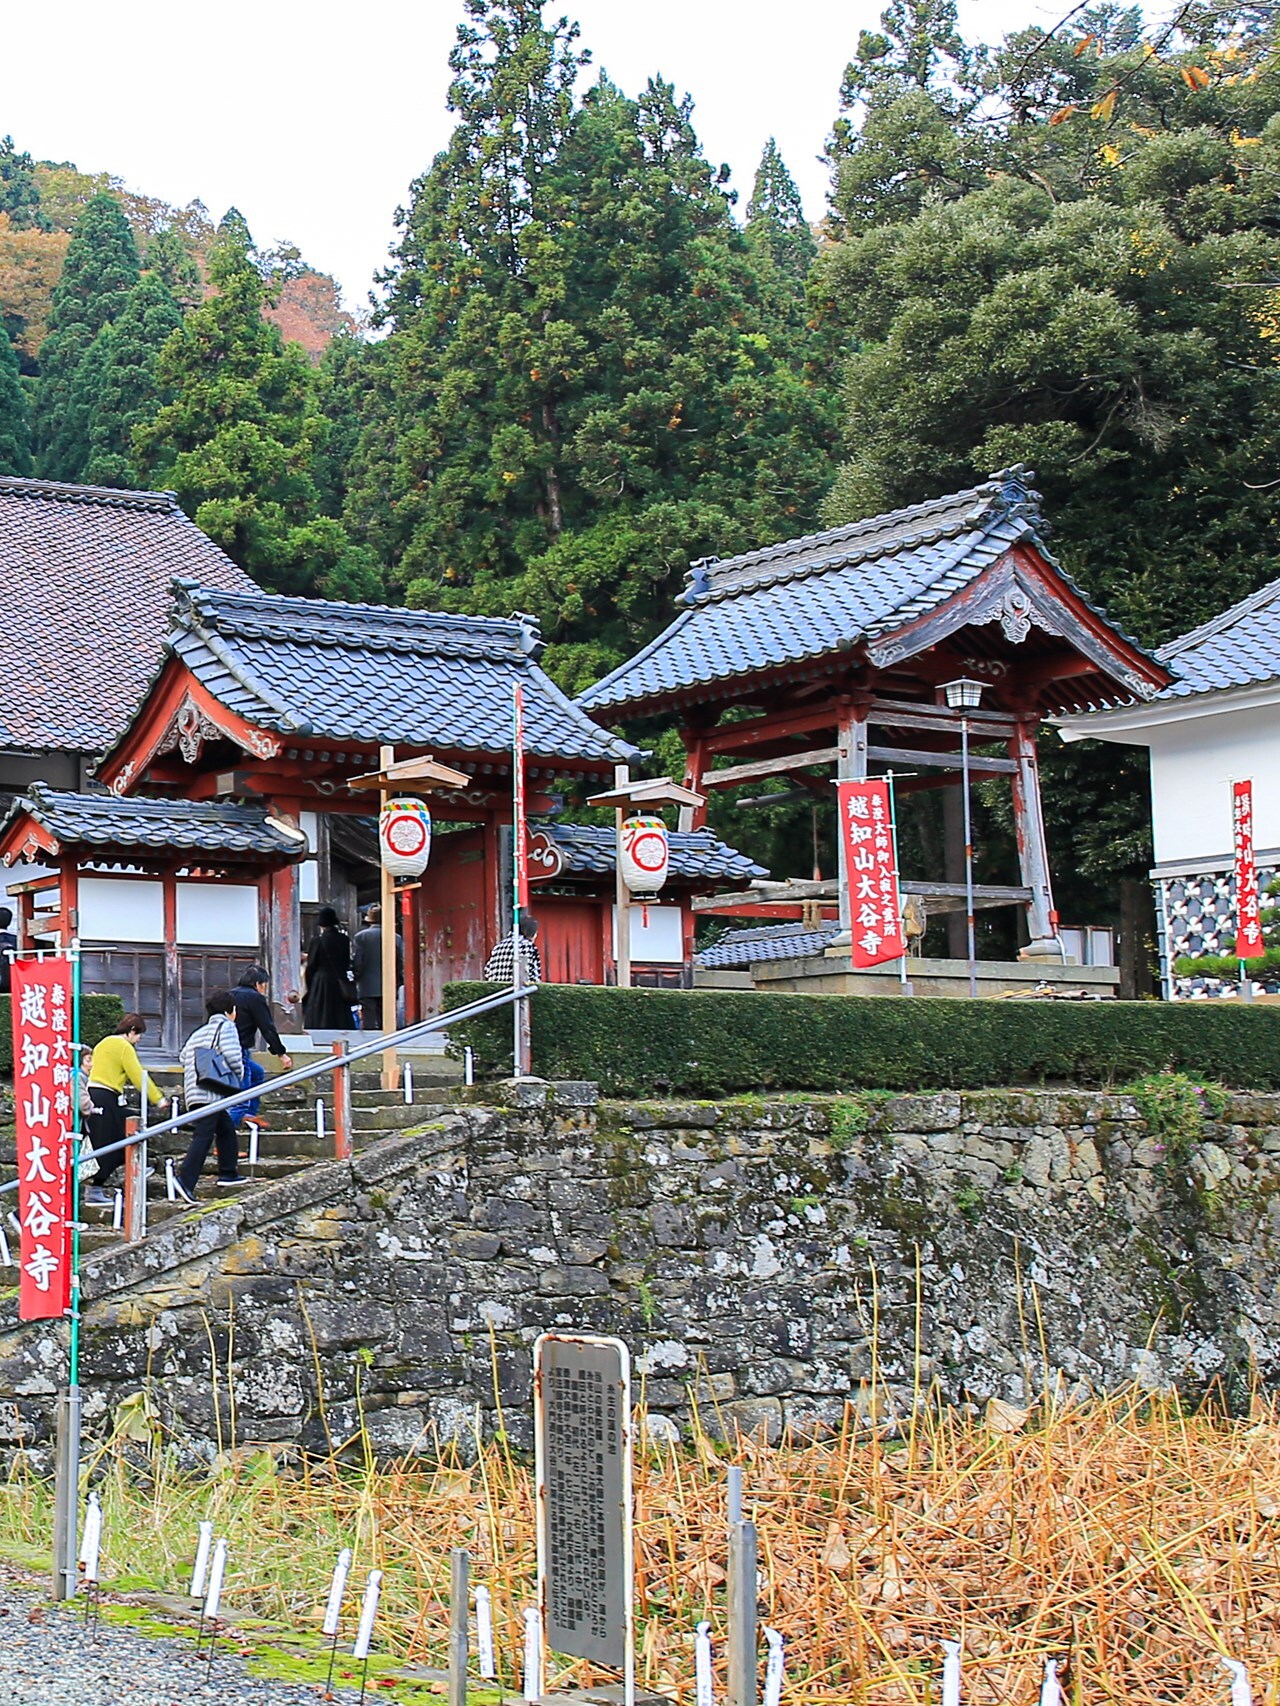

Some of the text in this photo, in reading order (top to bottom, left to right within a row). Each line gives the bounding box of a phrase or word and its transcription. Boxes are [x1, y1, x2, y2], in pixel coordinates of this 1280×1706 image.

[847, 795, 883, 956] 越知山大谷寺
[19, 983, 60, 1292] 越知山大谷寺
